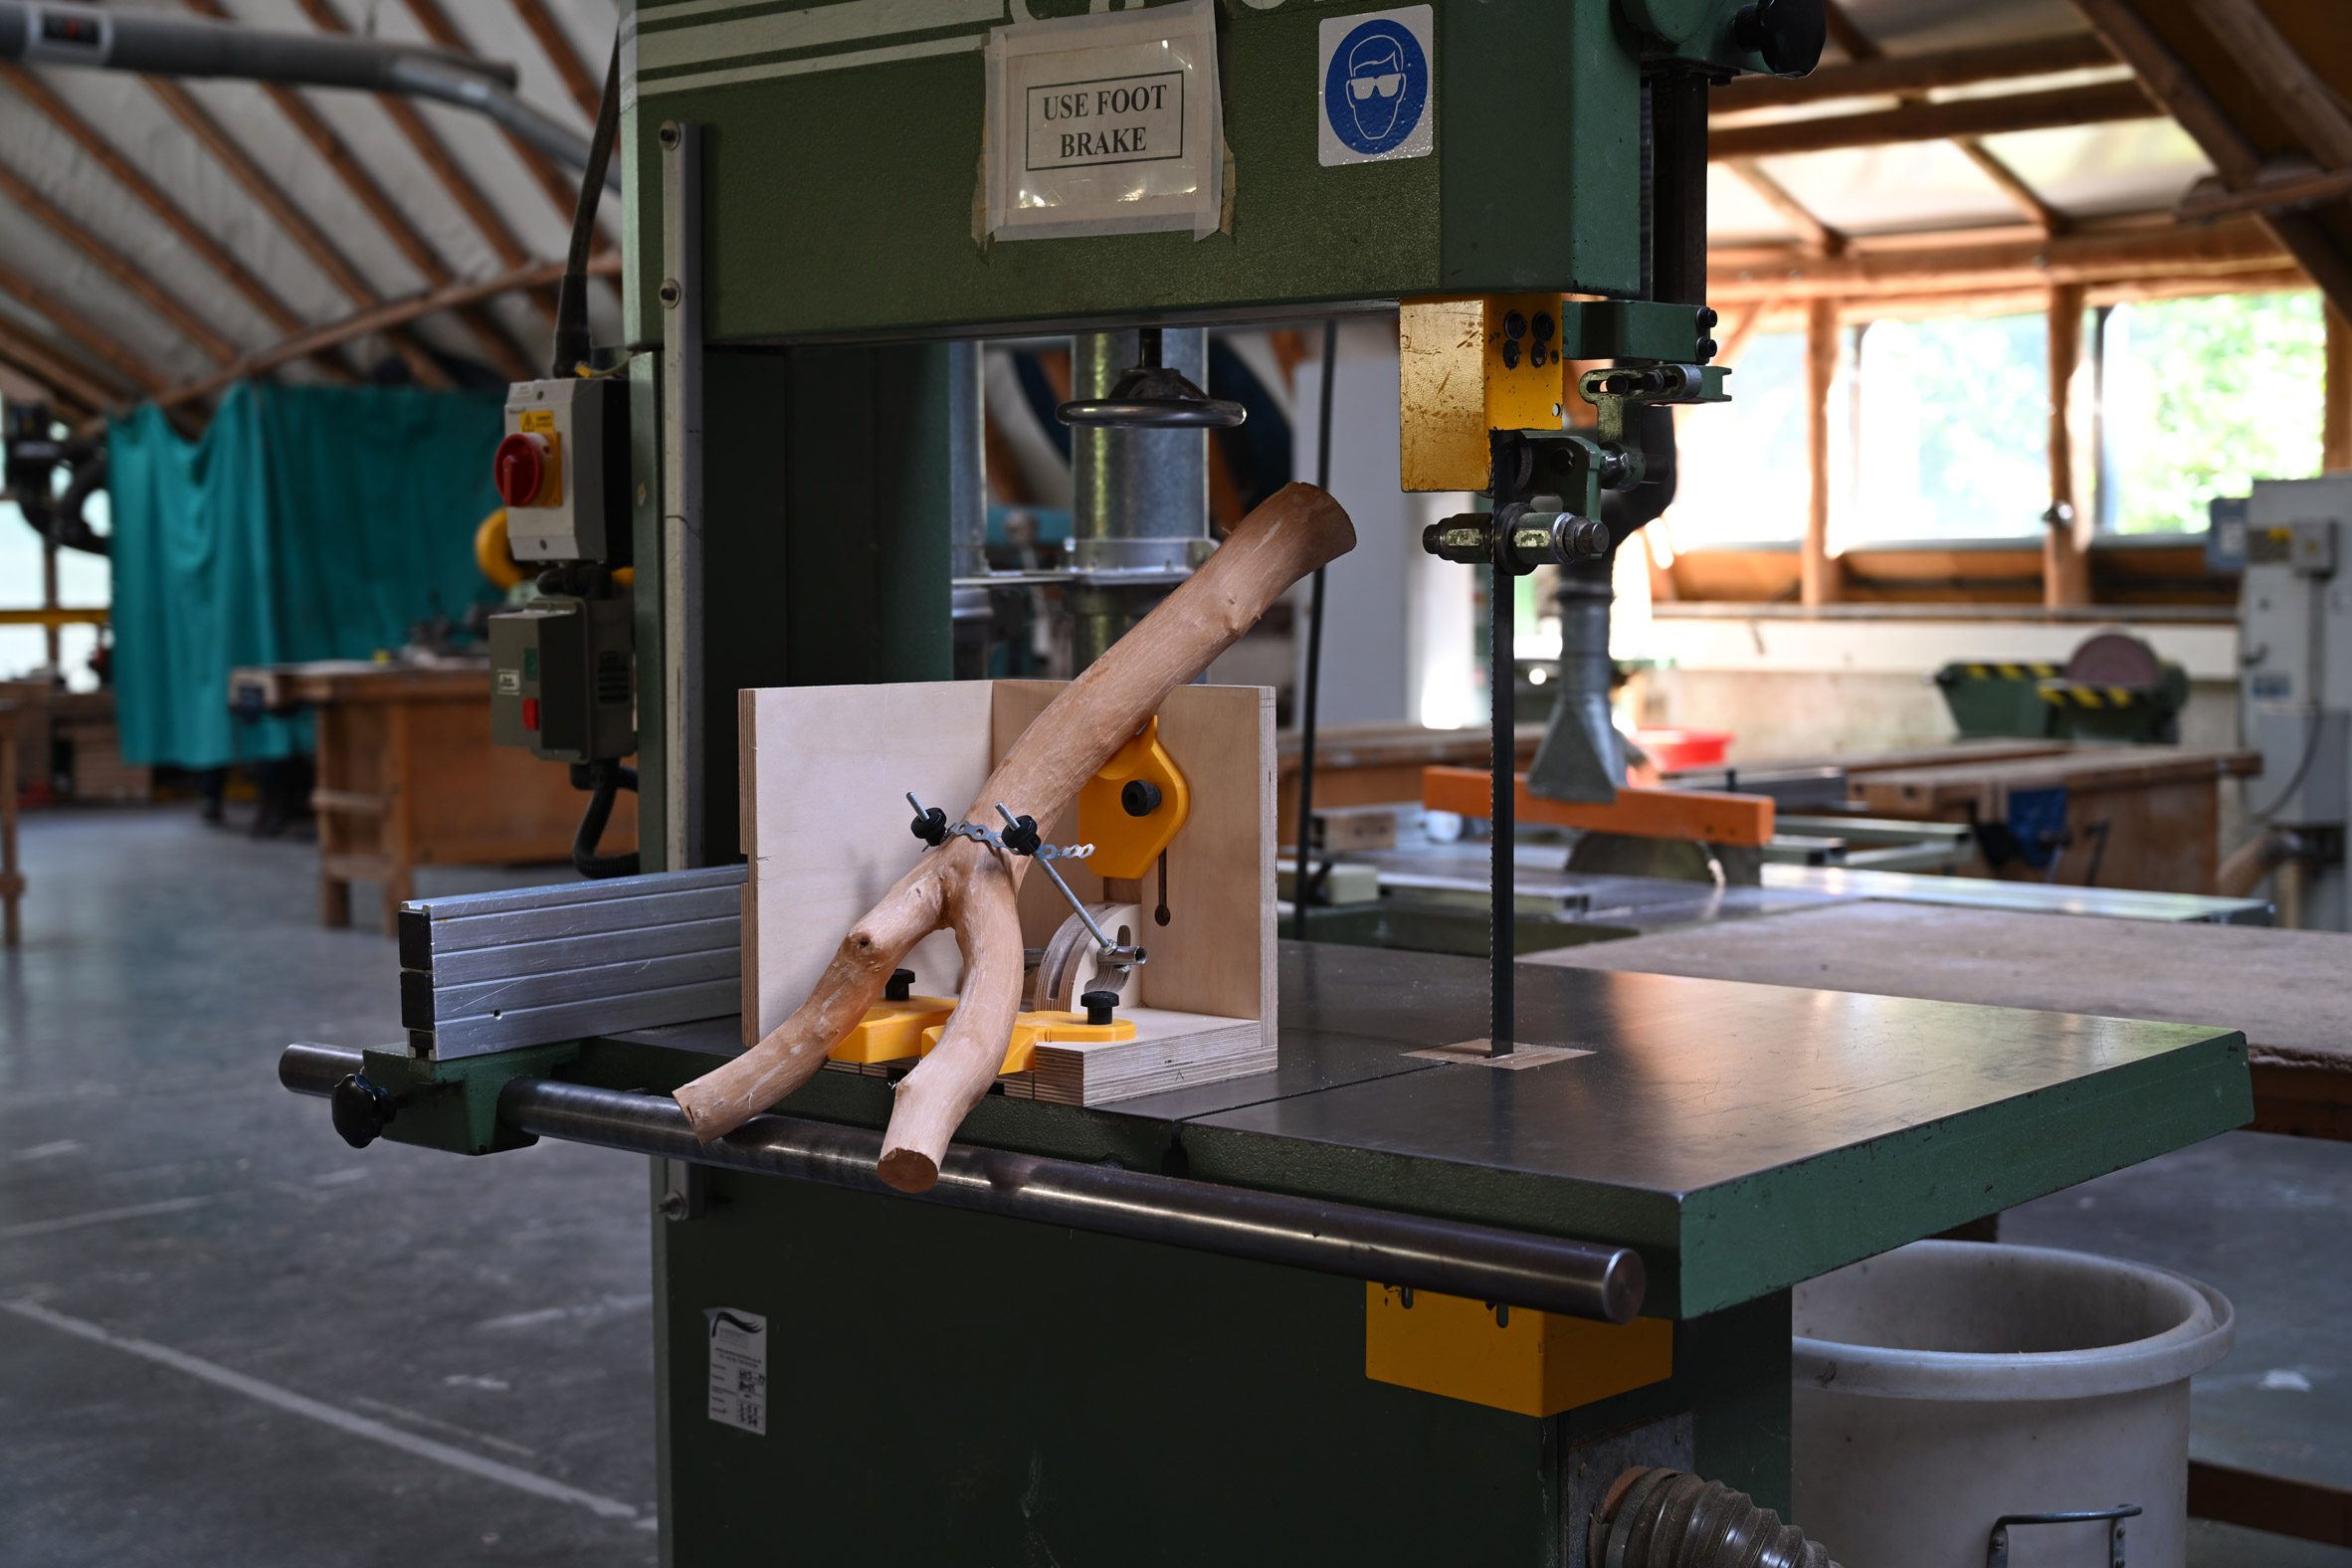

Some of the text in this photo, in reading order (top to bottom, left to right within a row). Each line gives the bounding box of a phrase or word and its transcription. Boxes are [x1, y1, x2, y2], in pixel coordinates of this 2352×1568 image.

[1043, 85, 1167, 120] USE FOOT
[1060, 127, 1147, 158] BRAKE
